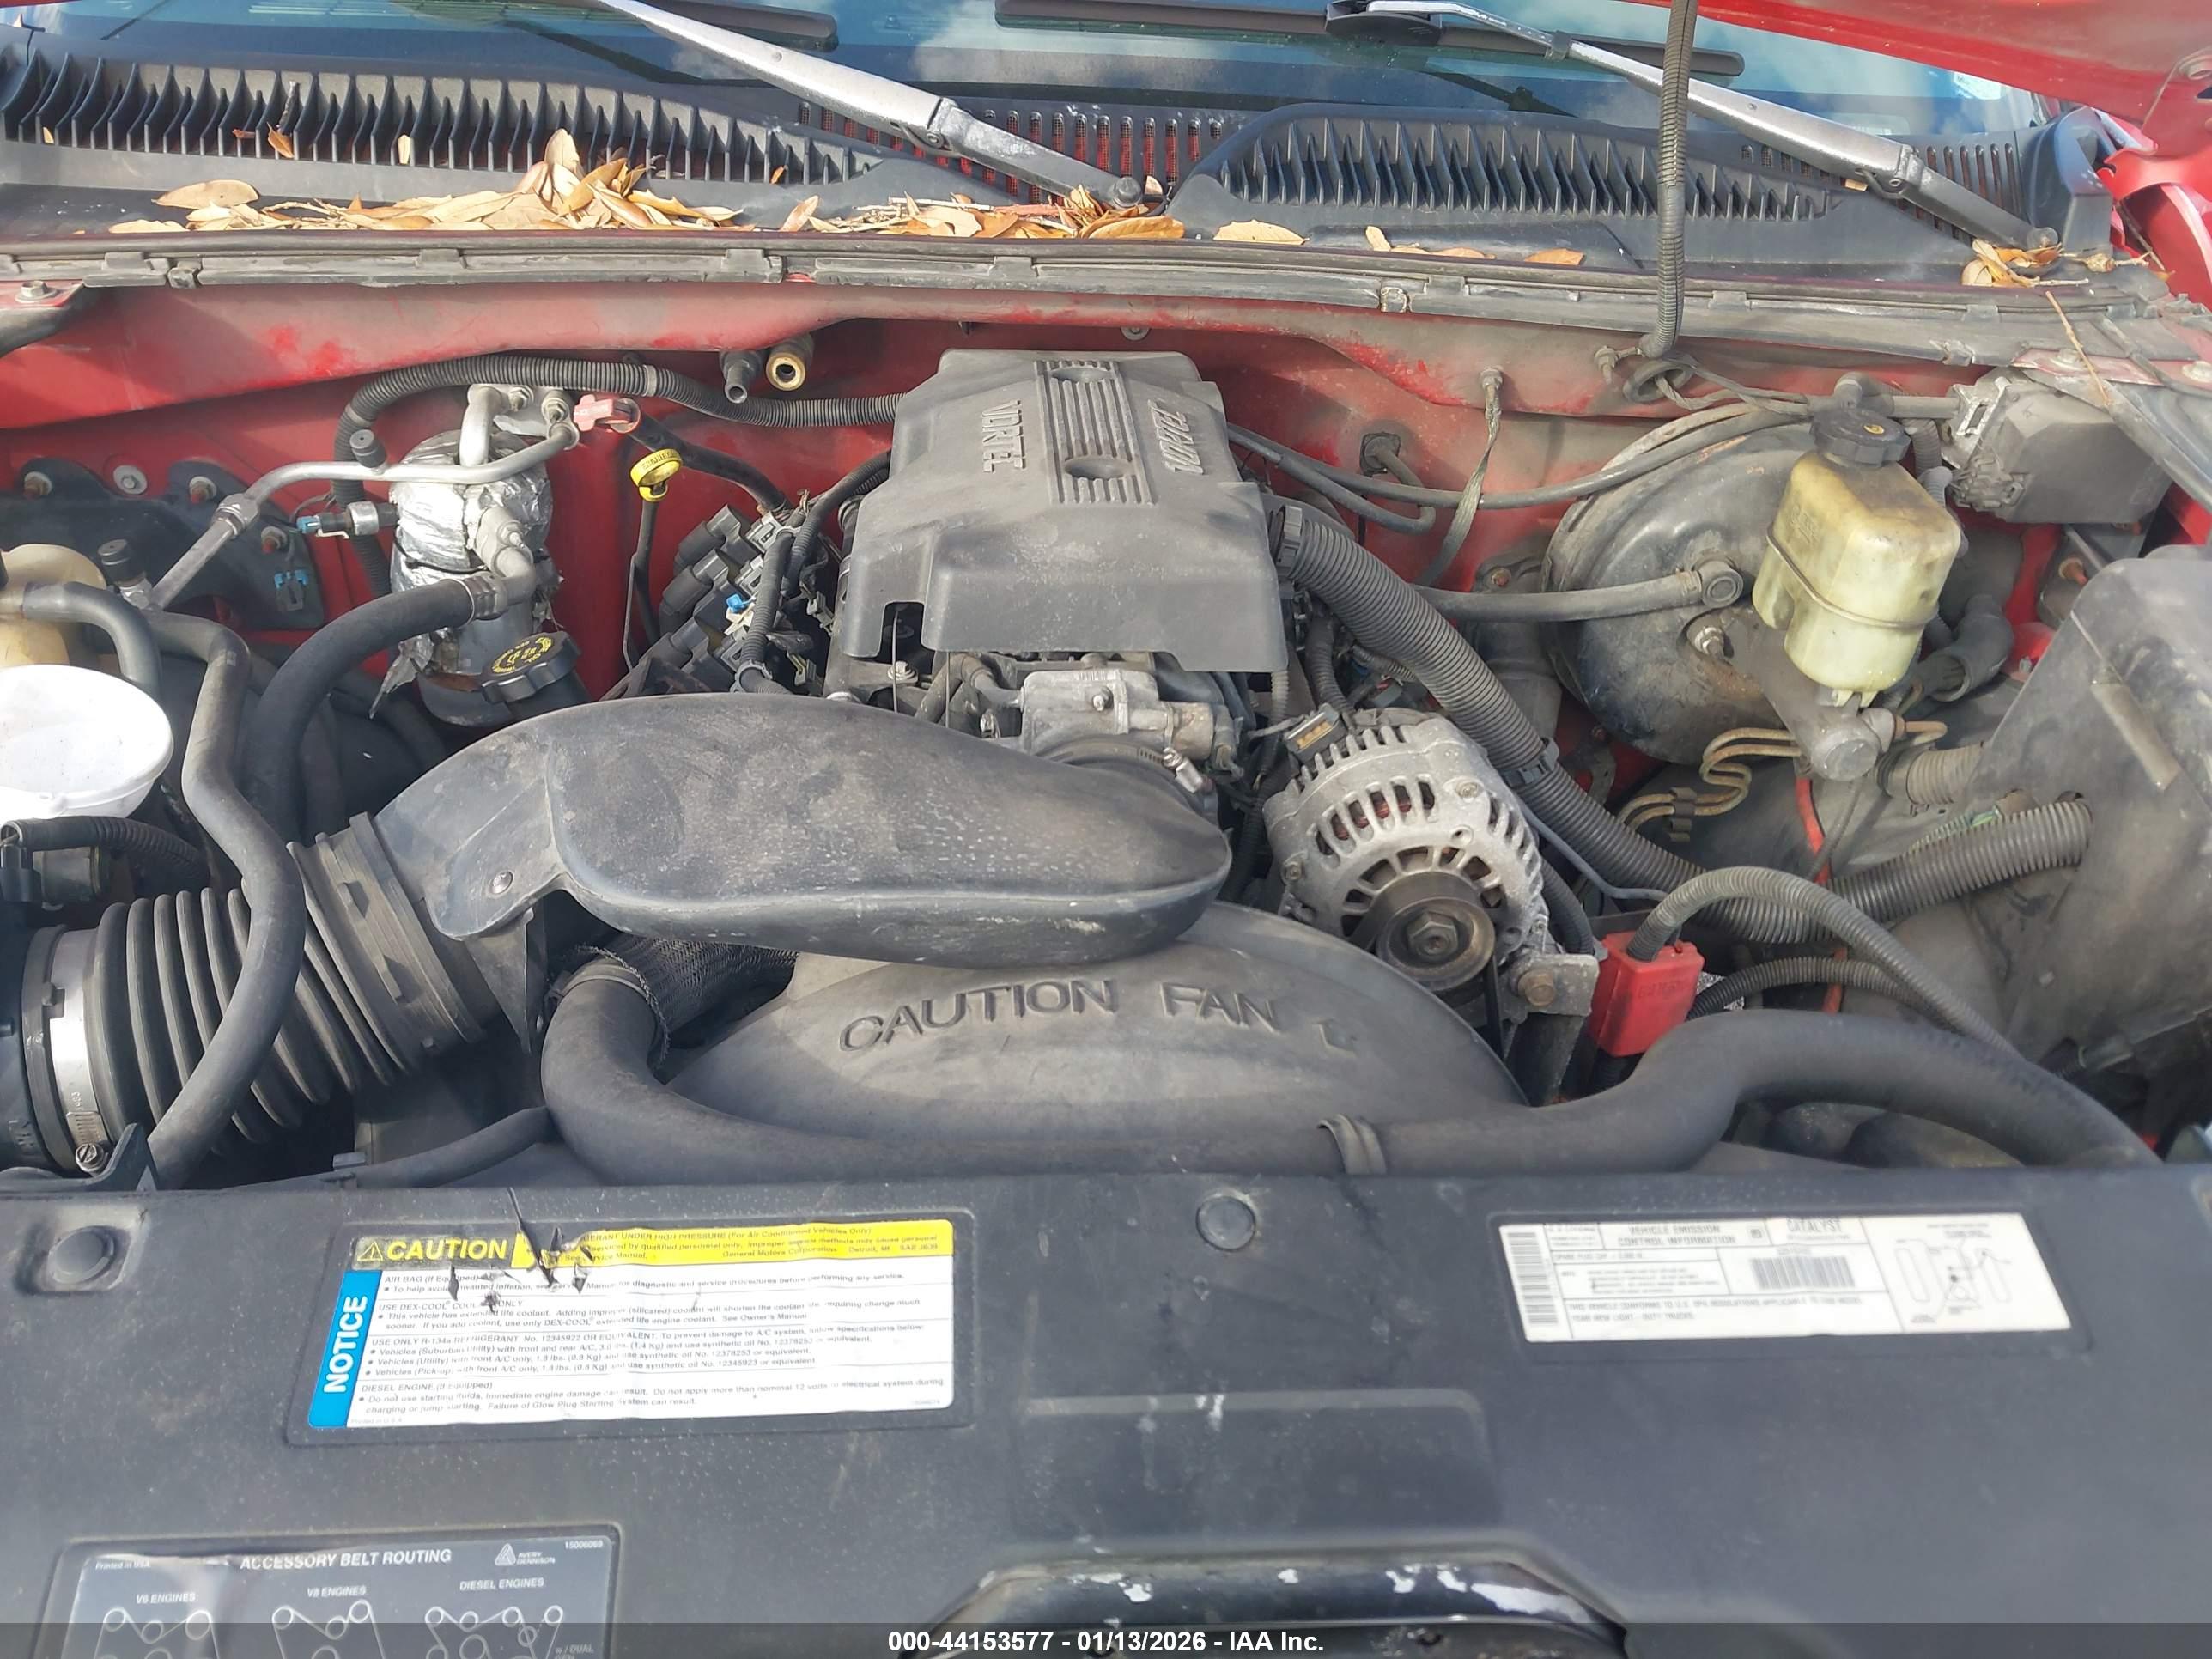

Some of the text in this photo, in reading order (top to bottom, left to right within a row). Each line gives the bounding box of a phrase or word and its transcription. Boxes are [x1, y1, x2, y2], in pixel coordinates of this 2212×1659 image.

[981, 399, 1026, 473] VORTEC
[1147, 398, 1204, 475] VORTEC
[838, 978, 1280, 1053] CAUTION FAN
[1630, 1224, 1720, 1236] VEHICLE EMISSION
[1787, 1218, 1842, 1232] CATALYST
[622, 1232, 652, 1241] UNDER
[1668, 1235, 1736, 1245] INFORMATION
[386, 1240, 507, 1260] CAUTION
[788, 1247, 837, 1255] Corporation
[496, 1282, 532, 1291] inflation,
[633, 1279, 677, 1288] diagnostic
[808, 1274, 853, 1283] performing
[556, 1310, 586, 1318] Adding
[629, 1306, 671, 1315] (silicated)
[865, 1299, 894, 1308] change
[523, 1320, 542, 1328] only
[652, 1316, 681, 1325] engine
[708, 1330, 742, 1339] damage
[323, 1296, 368, 1394] NOTICE
[649, 1342, 664, 1351] Kg)
[416, 1357, 449, 1365] (Utility)
[514, 1355, 533, 1364] only,
[568, 1353, 584, 1362] (0.8
[586, 1353, 602, 1363] Kg)
[640, 1352, 678, 1361] synthetic
[765, 1347, 811, 1357] equivalent.
[574, 1364, 590, 1372] (0.8
[592, 1364, 607, 1372] Kg)
[646, 1362, 685, 1370] synthetic
[384, 1394, 398, 1402] not
[567, 1390, 601, 1399] damage
[757, 1383, 793, 1392] nominal
[883, 1379, 914, 1388] system
[915, 1378, 944, 1387] during
[366, 1406, 406, 1415] charging
[558, 1400, 577, 1408] Plug
[580, 1400, 614, 1408] Starting
[669, 1397, 697, 1406] result.
[95, 1561, 123, 1570] Printed
[240, 1549, 452, 1570] ACCESSORY BELT ROUTING
[307, 1585, 367, 1597] V8 ENGINES
[459, 1577, 544, 1591] DIESEL ENGINES
[137, 1592, 196, 1604] V6 ENGINES
